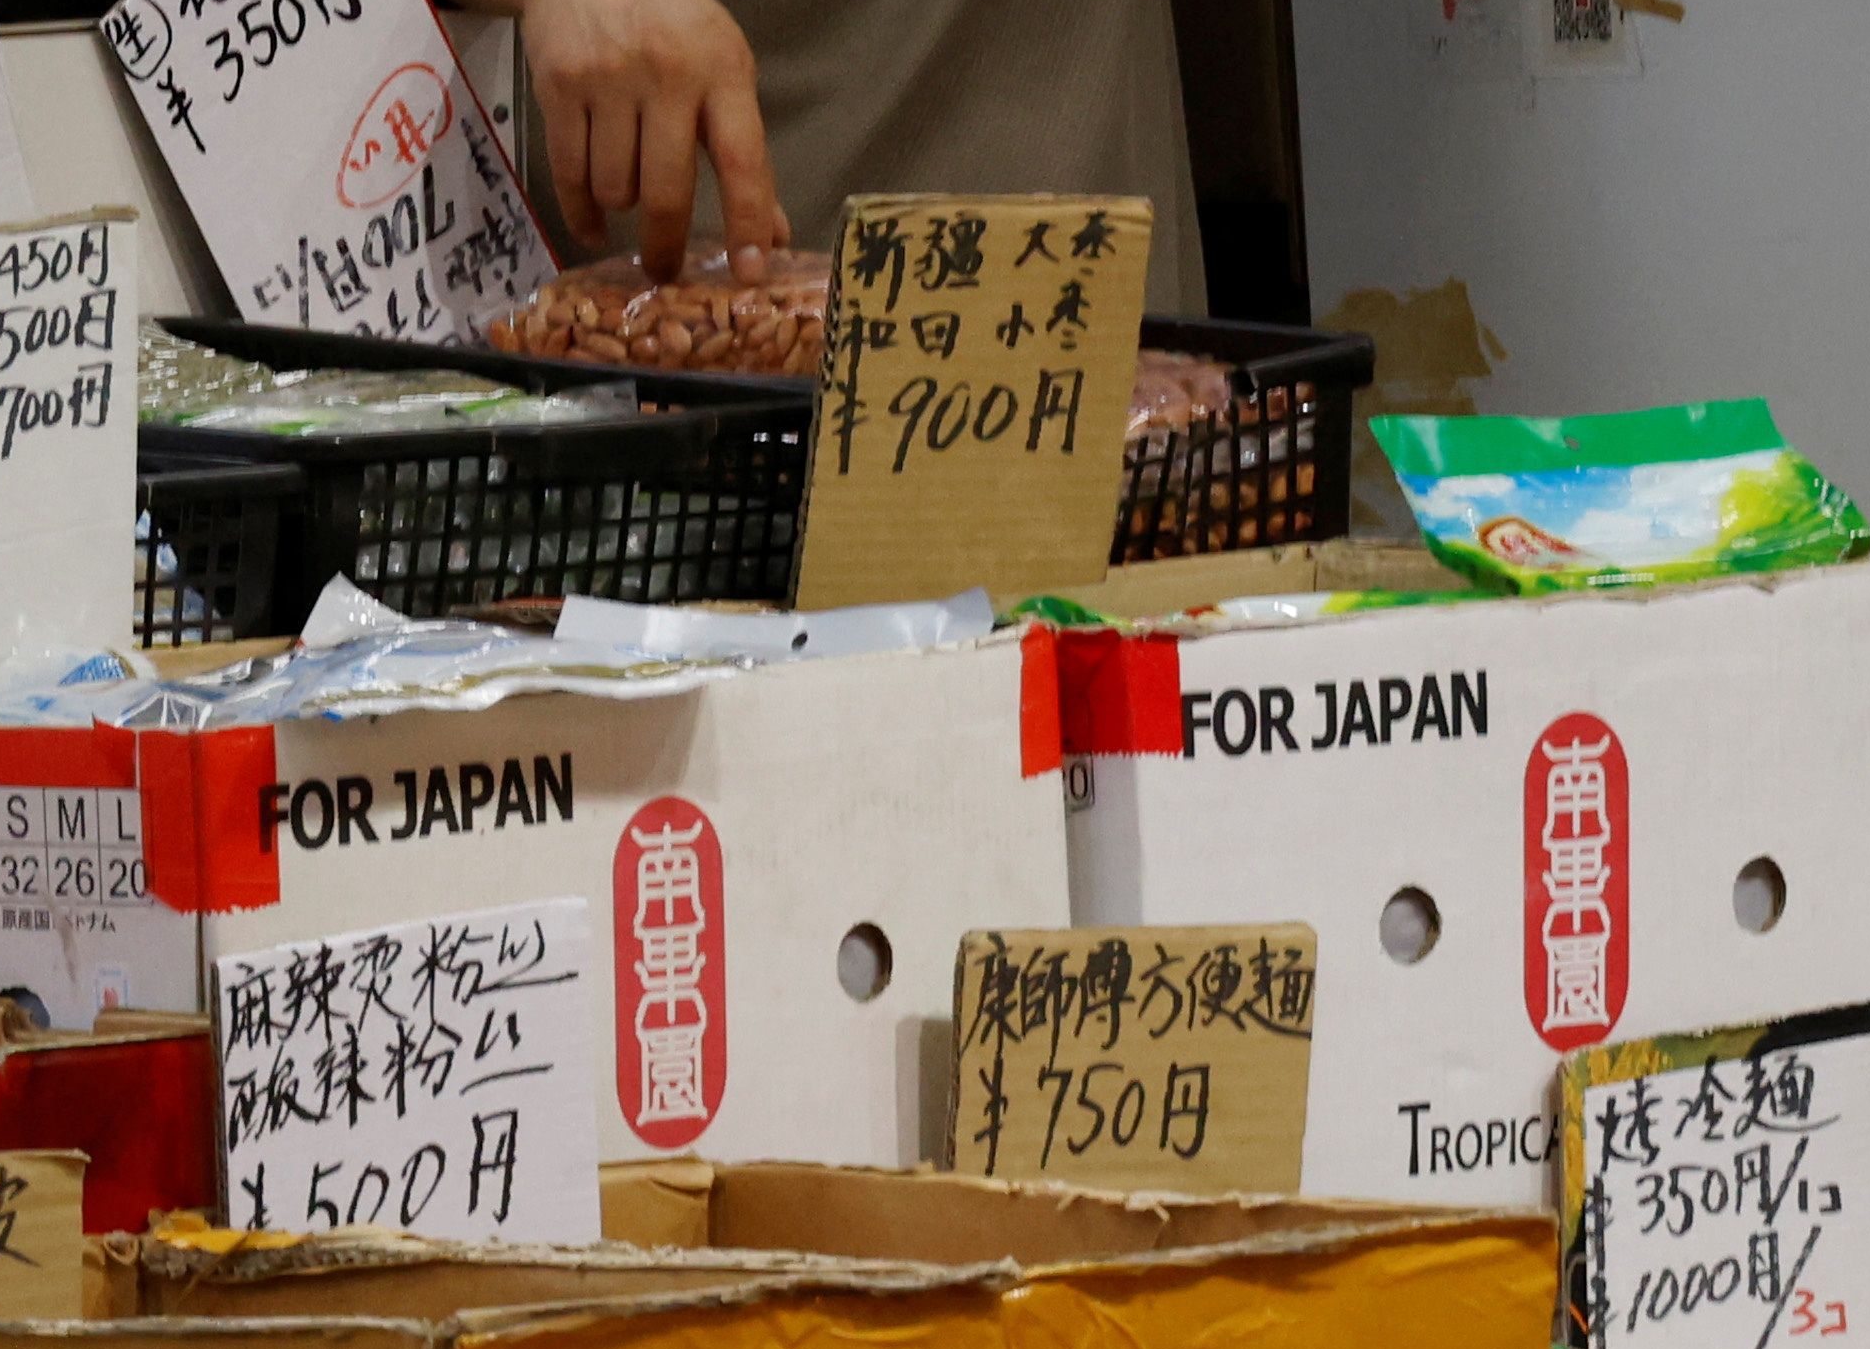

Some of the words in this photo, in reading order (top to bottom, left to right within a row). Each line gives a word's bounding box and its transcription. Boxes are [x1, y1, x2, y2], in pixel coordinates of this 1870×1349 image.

[830, 368, 1085, 475] ¥900円
[1181, 682, 1297, 759] FOR
[1310, 669, 1491, 748] JAPAN
[5, 793, 30, 841] S
[57, 792, 88, 842] M
[116, 791, 138, 842] L
[258, 774, 380, 854] FOR
[390, 752, 575, 841] JAPAN
[0, 854, 41, 899] 32
[53, 857, 96, 899] 26
[107, 855, 149, 900] 20
[973, 1058, 1211, 1178] ¥750円
[240, 1107, 520, 1232] ¥500円
